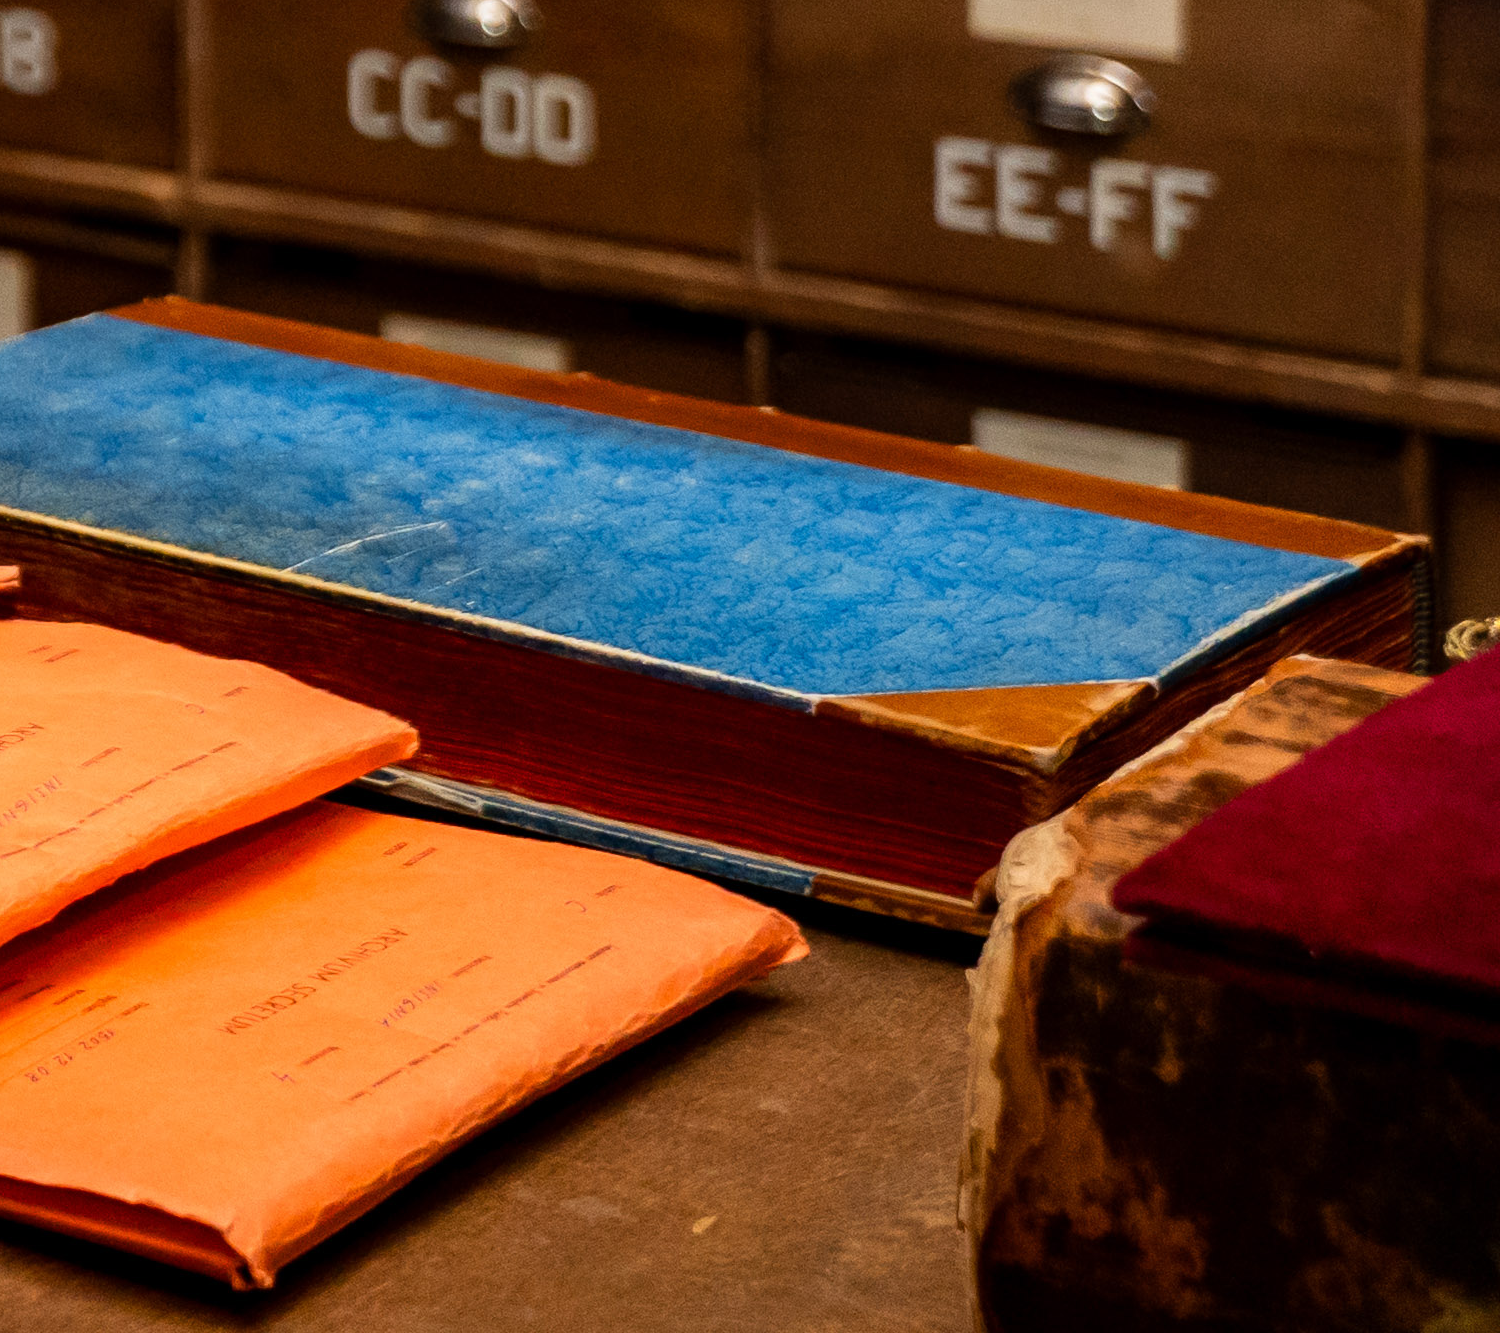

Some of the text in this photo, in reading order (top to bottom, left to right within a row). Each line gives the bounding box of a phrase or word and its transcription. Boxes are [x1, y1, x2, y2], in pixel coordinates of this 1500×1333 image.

[348, 51, 592, 163] CC-DD
[933, 136, 1215, 259] EE-FF
[217, 927, 408, 1036] ARCHIVUM SECRETUM
[377, 979, 442, 1028] INSIGNIA
